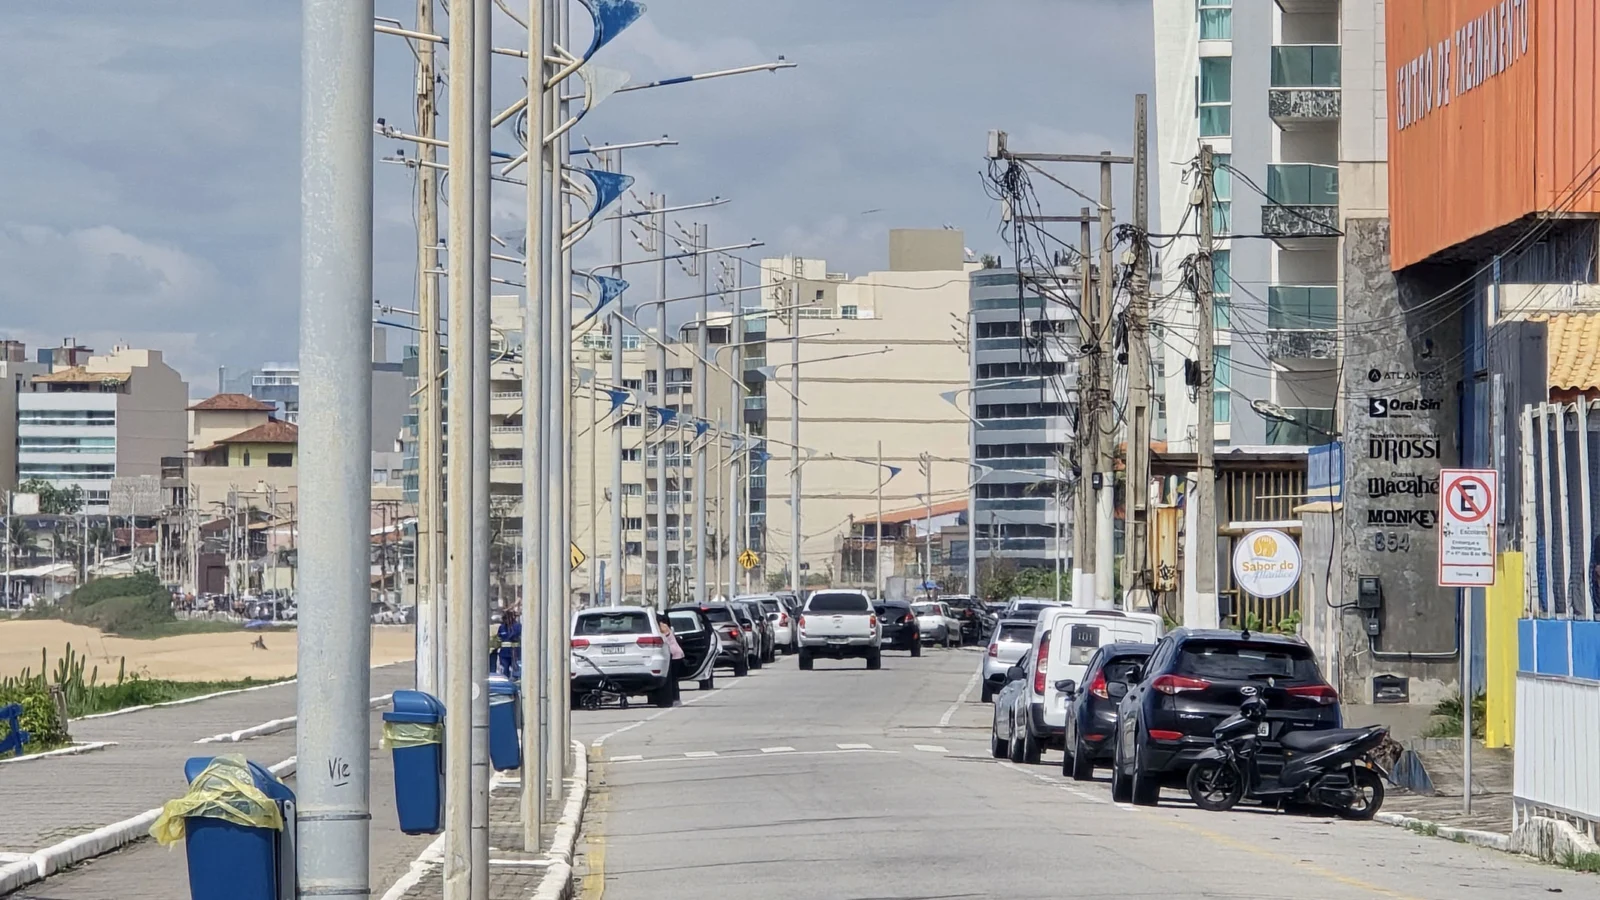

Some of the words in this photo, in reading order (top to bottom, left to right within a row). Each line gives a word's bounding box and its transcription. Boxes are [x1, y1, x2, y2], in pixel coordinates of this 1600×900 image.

[1396, 46, 1434, 131] CENTRO
[1437, 38, 1451, 109] DE
[1455, 0, 1528, 97] TREINAMENTO
[1389, 399, 1418, 411] Oral
[1369, 439, 1441, 465] D'ROSSI
[1367, 509, 1440, 529] MONKEY
[1242, 562, 1277, 572] Sabor
[1280, 560, 1294, 570] do
